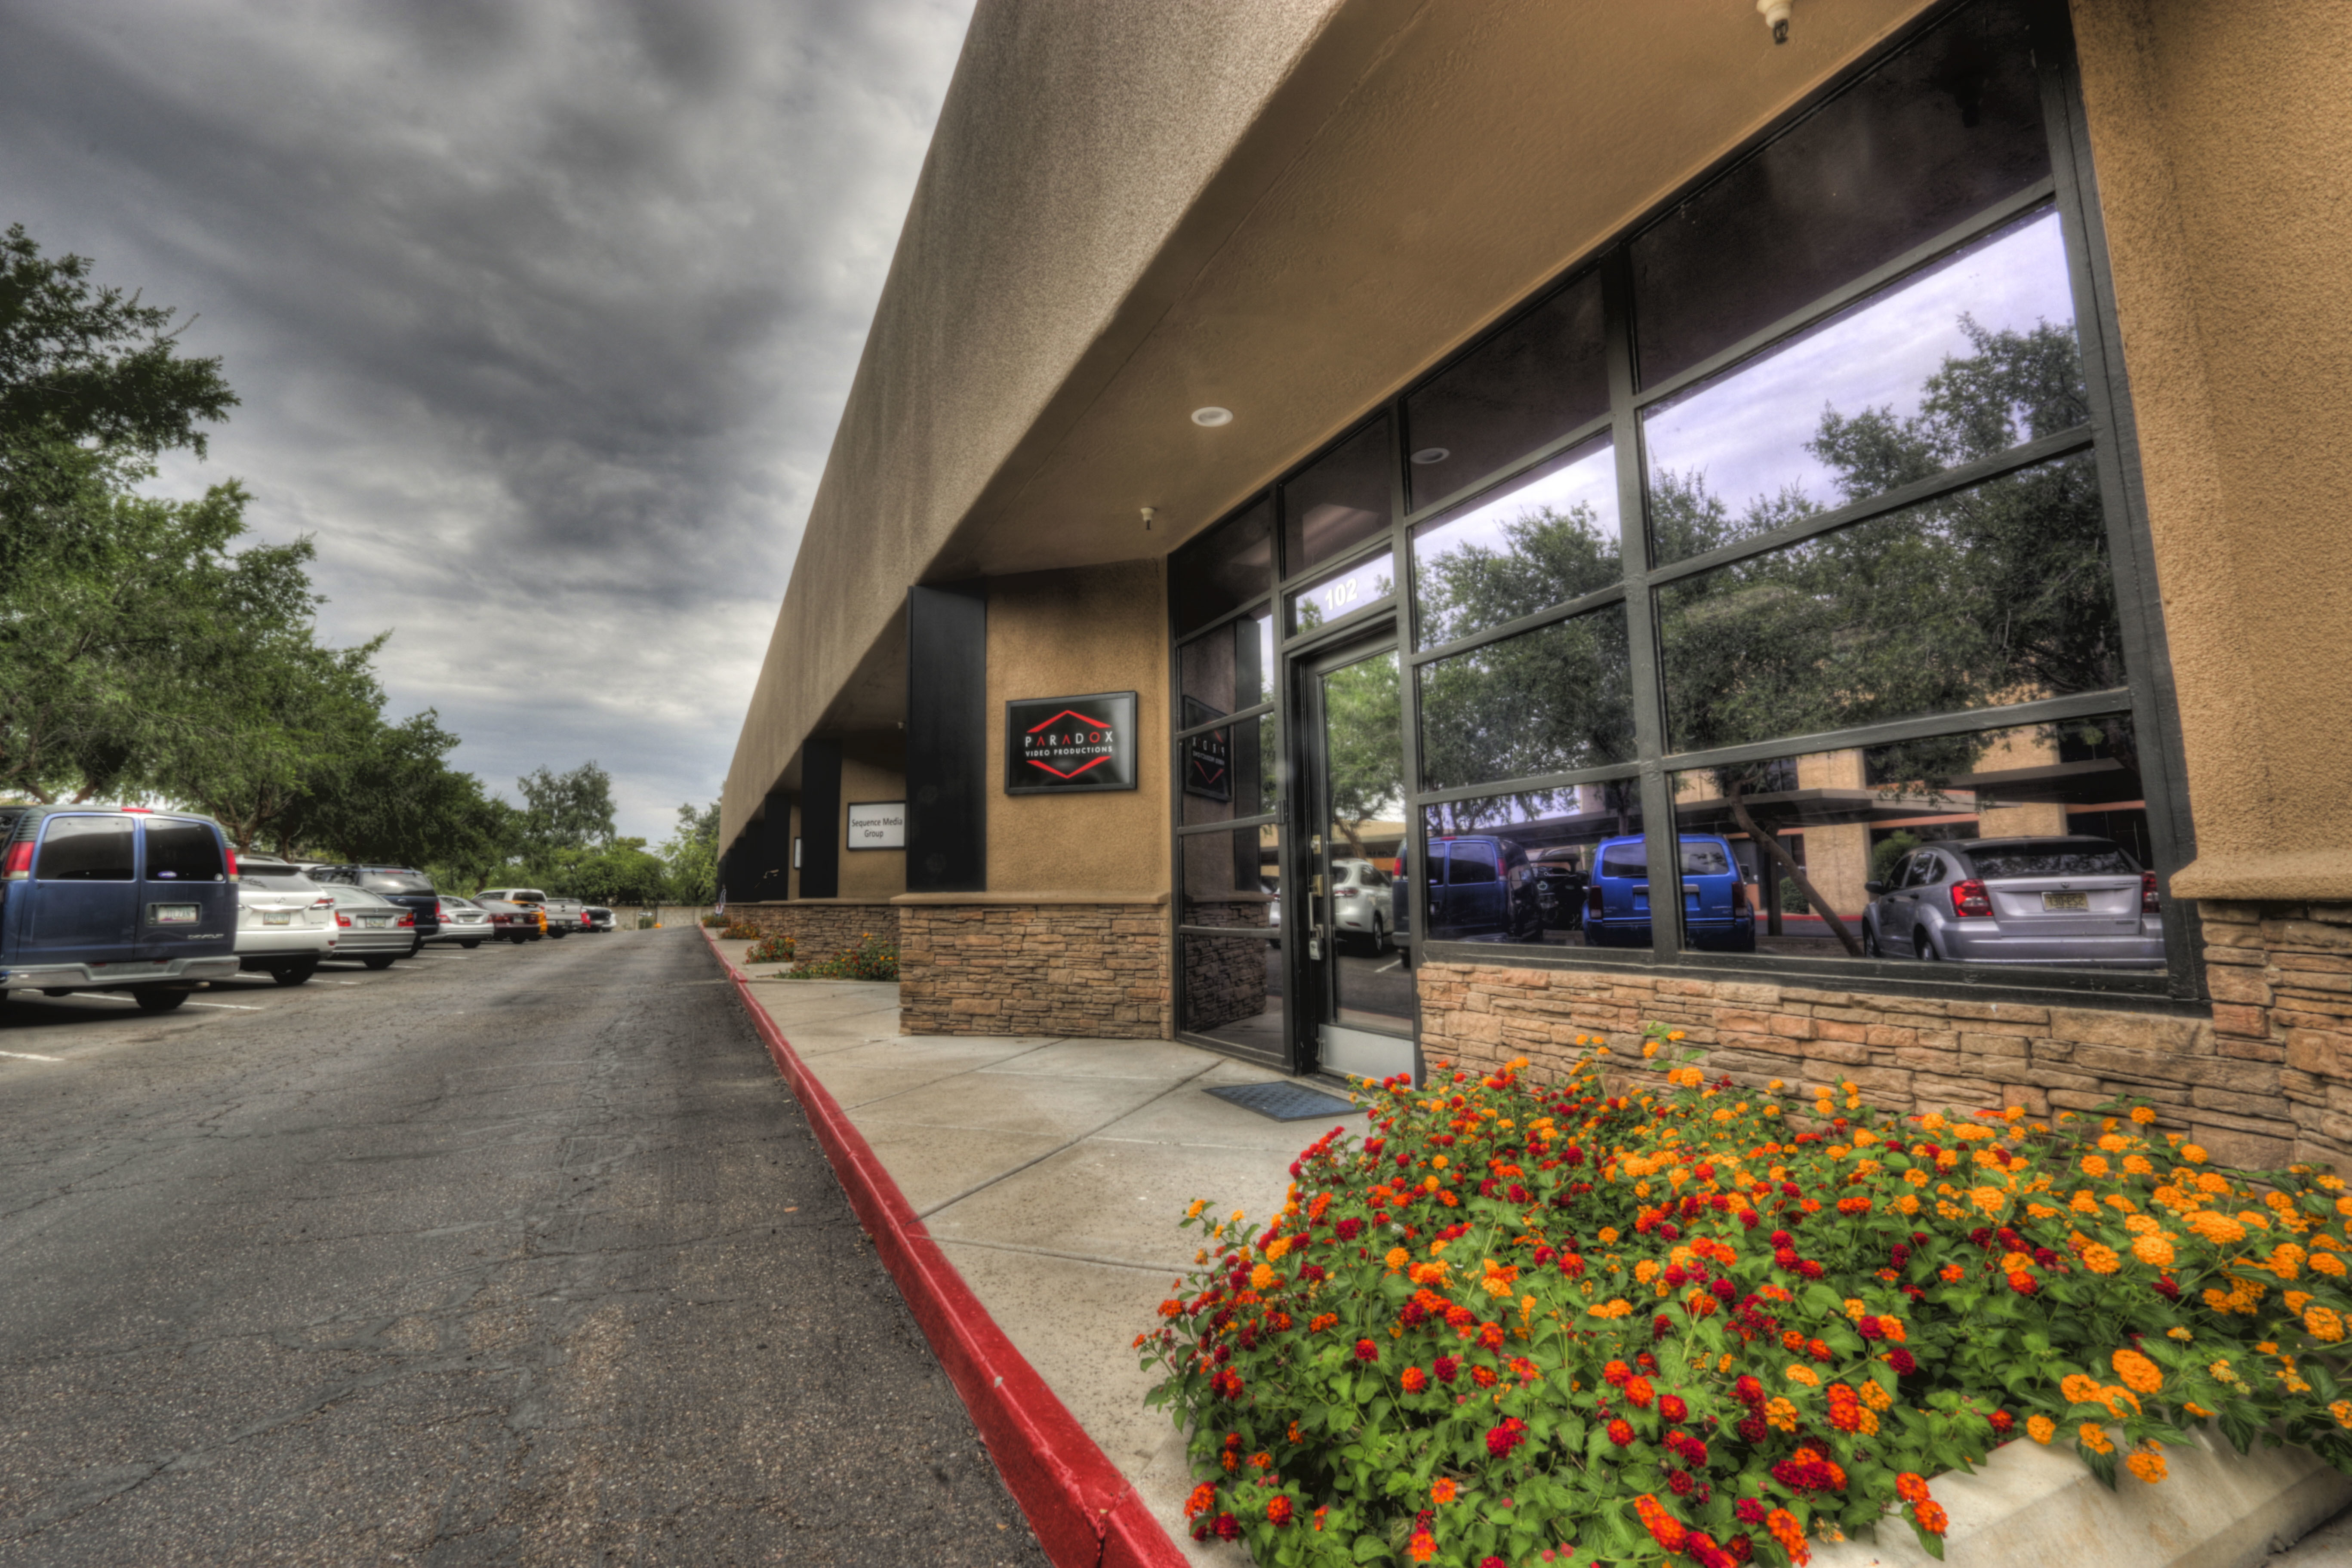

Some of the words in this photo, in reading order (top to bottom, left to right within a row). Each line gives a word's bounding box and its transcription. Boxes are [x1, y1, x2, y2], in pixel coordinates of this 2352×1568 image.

[1325, 578, 1358, 610] 102
[1025, 731, 1113, 747] PARADOX
[1054, 745, 1112, 755] PRODUCTIONS
[852, 819, 881, 829] Sequence
[883, 817, 903, 826] Media
[864, 829, 884, 838] Group
